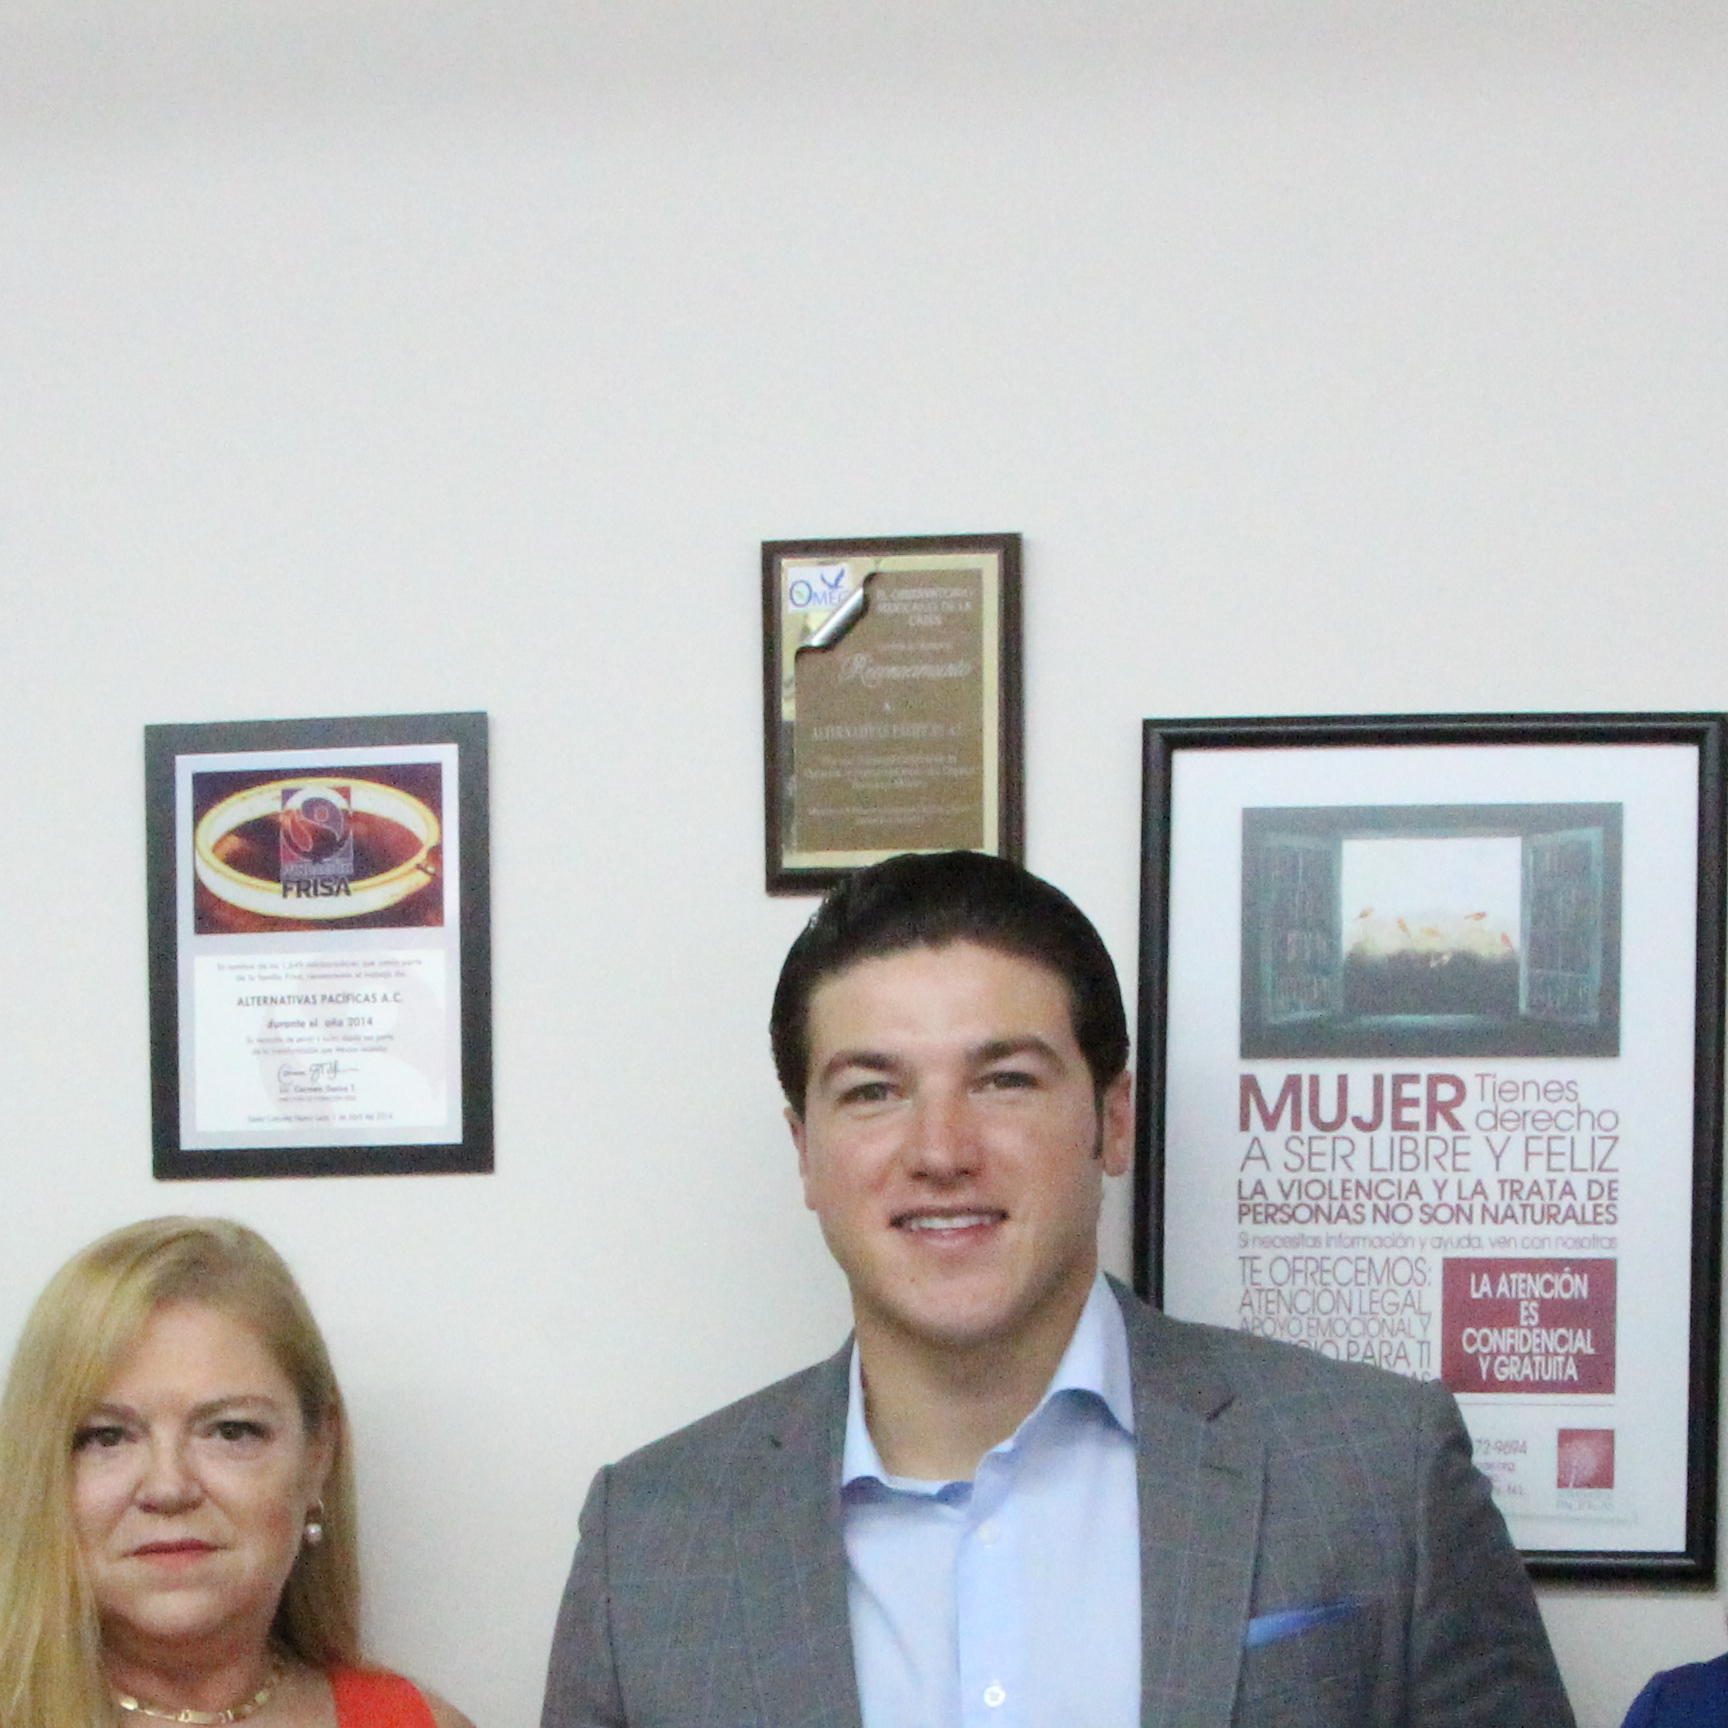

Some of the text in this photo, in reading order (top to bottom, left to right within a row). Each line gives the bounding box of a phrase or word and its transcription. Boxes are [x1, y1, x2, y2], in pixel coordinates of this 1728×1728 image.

[789, 579, 846, 607] OMEG
[282, 876, 352, 899] FRISA
[236, 993, 317, 1008] ALTERNATIVAS
[1474, 1072, 1580, 1103] Tienes
[1237, 1072, 1467, 1133] MUJER
[1474, 1103, 1620, 1133] derecho
[1239, 1135, 1620, 1173] A SER LIBRE Y FELIZ
[1237, 1178, 1619, 1202] LA VIOLENCIA Y LA TRATA DE
[1237, 1201, 1618, 1226] PERSONAS NO SON NATURALES
[1252, 1231, 1322, 1249] necesitas
[1325, 1230, 1415, 1250] información
[1419, 1235, 1427, 1252] y
[1488, 1234, 1517, 1249] ven
[1520, 1234, 1550, 1249] con
[1238, 1256, 1432, 1287] TE OFRECEMOS:
[1470, 1266, 1589, 1299] LA ATENCIÓN
[1240, 1317, 1432, 1338] APOYO EMOCIONAL Y
[1518, 1300, 1540, 1327] ES
[1346, 1339, 1412, 1369] PARA
[1417, 1339, 1431, 1369] TI
[1461, 1327, 1596, 1355] CONFIDENCIAL
[1477, 1355, 1578, 1381] Y GRATUITA
